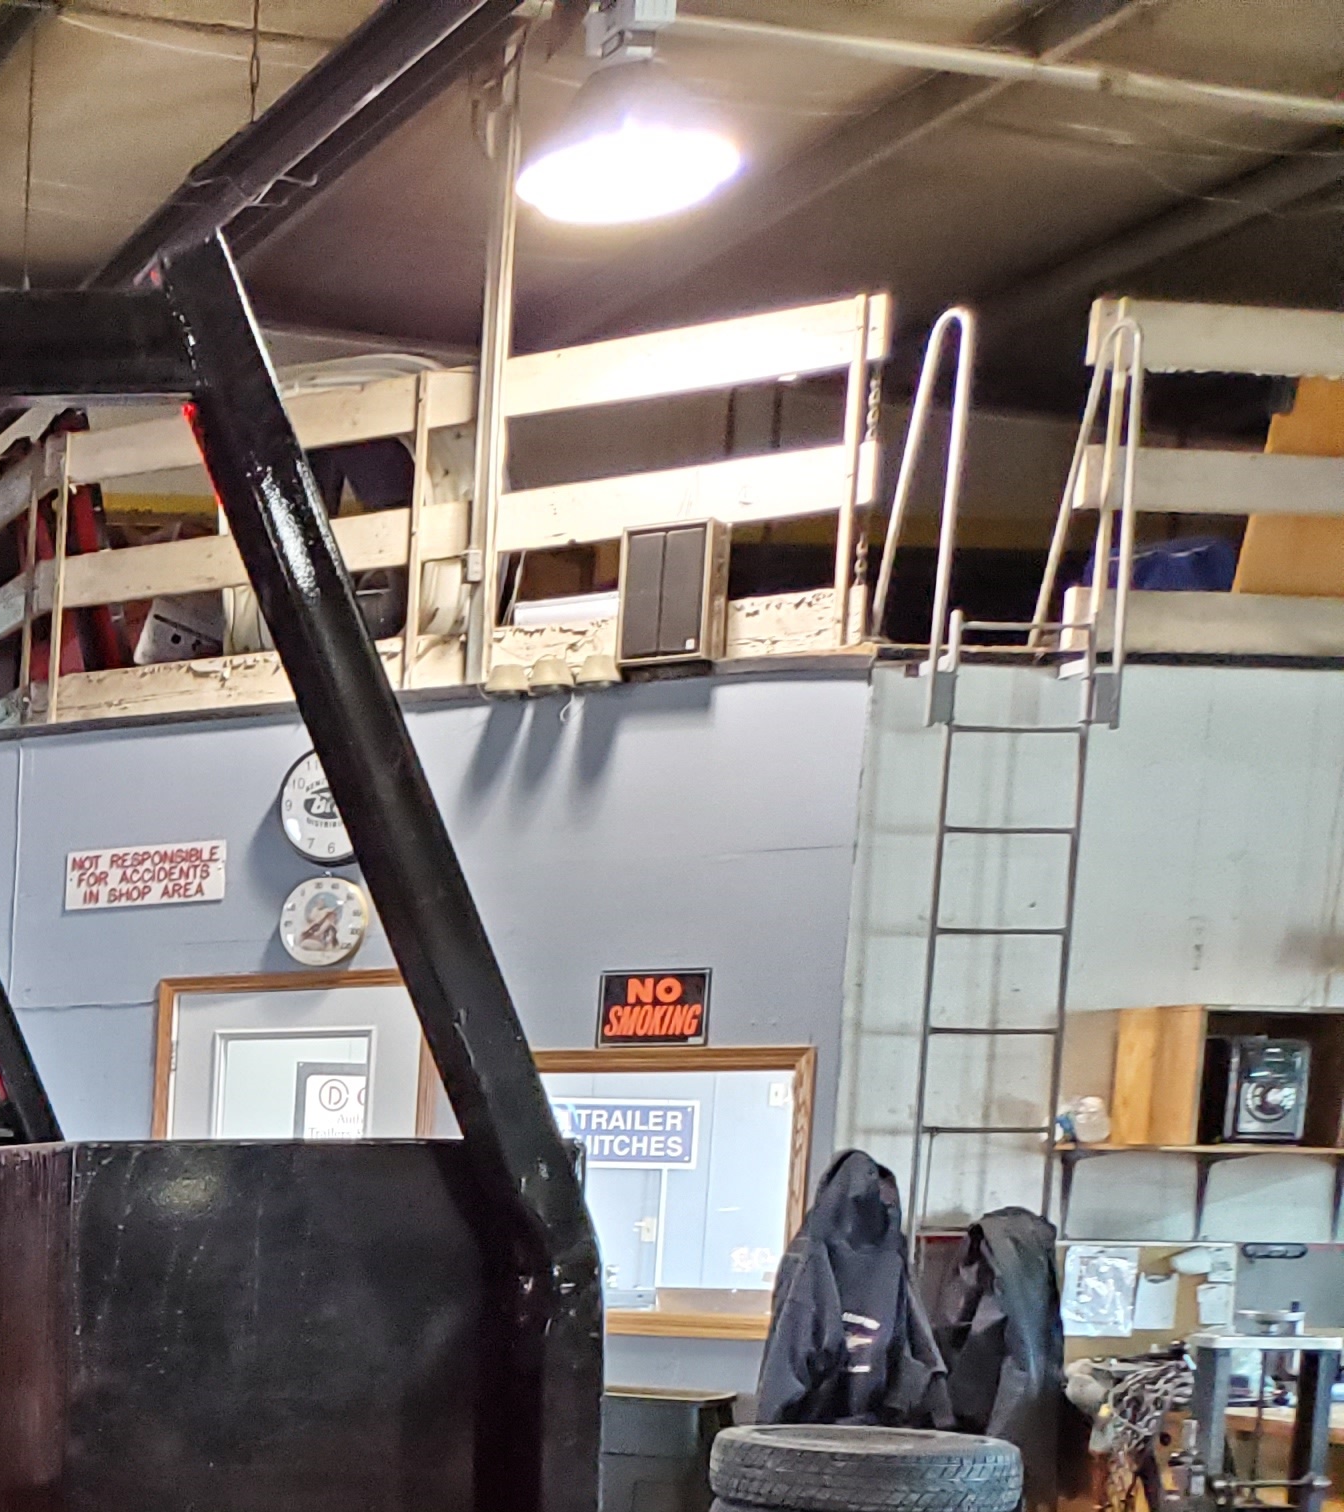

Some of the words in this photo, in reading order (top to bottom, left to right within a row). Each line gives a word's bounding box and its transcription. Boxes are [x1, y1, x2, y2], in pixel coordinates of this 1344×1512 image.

[292, 778, 305, 789] 10
[285, 800, 292, 811] 9
[307, 838, 315, 849] 7
[327, 842, 335, 854] 6
[72, 855, 101, 871] NOT
[110, 846, 220, 868] RESPONSIBLE
[77, 872, 109, 888] FOR
[119, 864, 210, 884] ACCIDENTS
[83, 889, 99, 904] IN
[107, 886, 151, 903] SHOP
[161, 882, 205, 899] AREA
[627, 977, 682, 1003] NO
[604, 1004, 701, 1036] SMOKING
[576, 1110, 682, 1131] TRAILER
